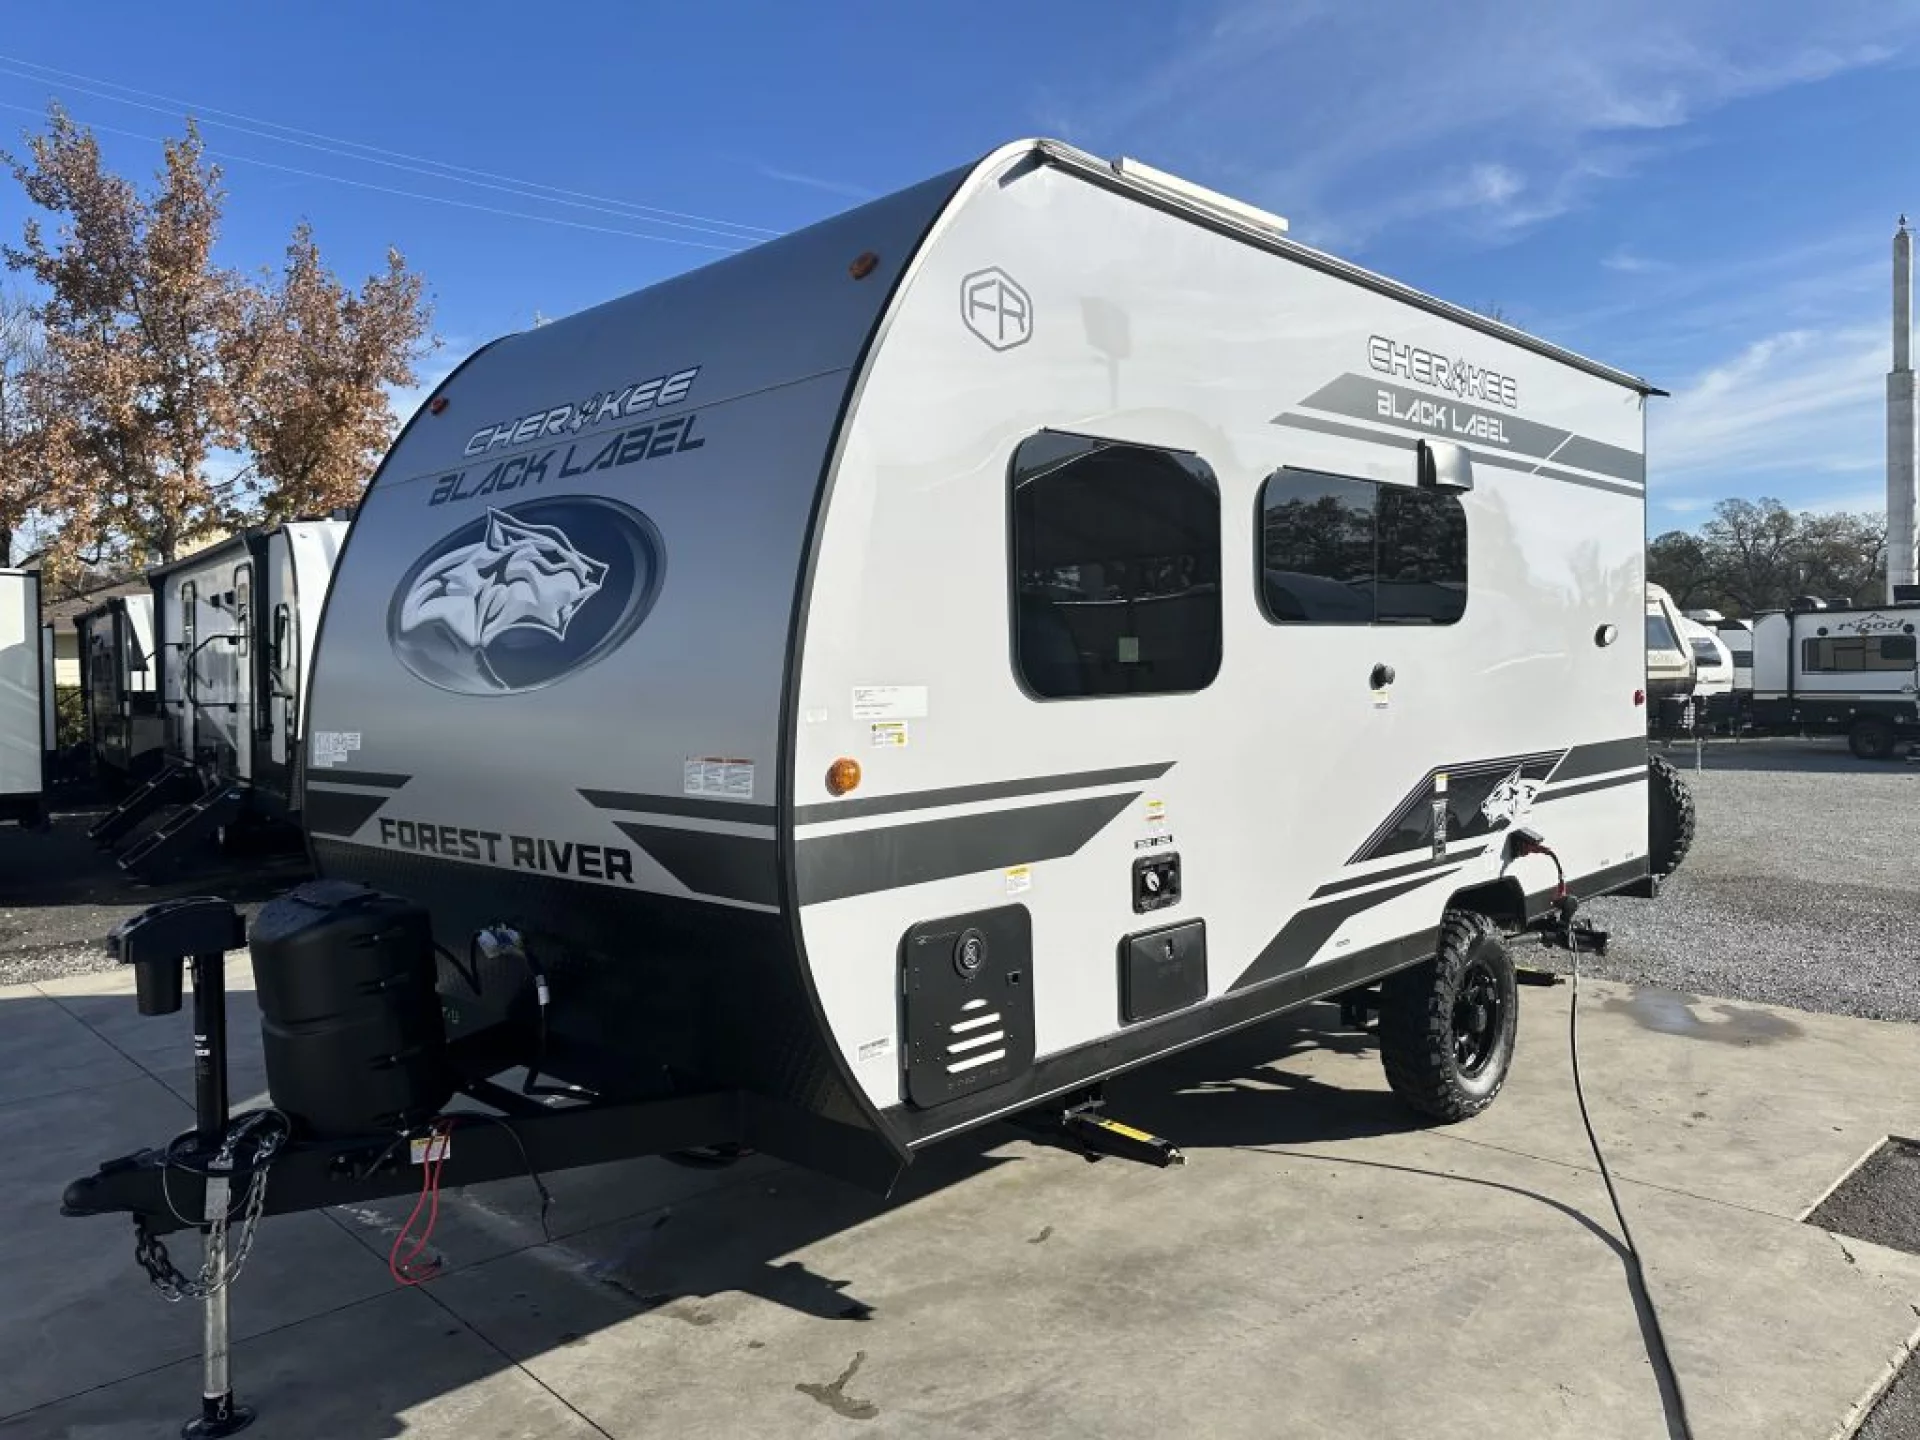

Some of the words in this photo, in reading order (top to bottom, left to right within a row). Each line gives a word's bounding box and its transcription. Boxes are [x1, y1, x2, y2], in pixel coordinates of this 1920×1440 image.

[1367, 334, 1518, 409] CHEROKEE
[463, 365, 702, 458] CHEROKEE
[1377, 389, 1447, 430] BLACK
[1452, 408, 1510, 444] LABEL
[429, 450, 555, 507] BLACK
[558, 415, 706, 479] LABEL
[379, 817, 502, 864] FOREST
[509, 835, 634, 884] RIVER
